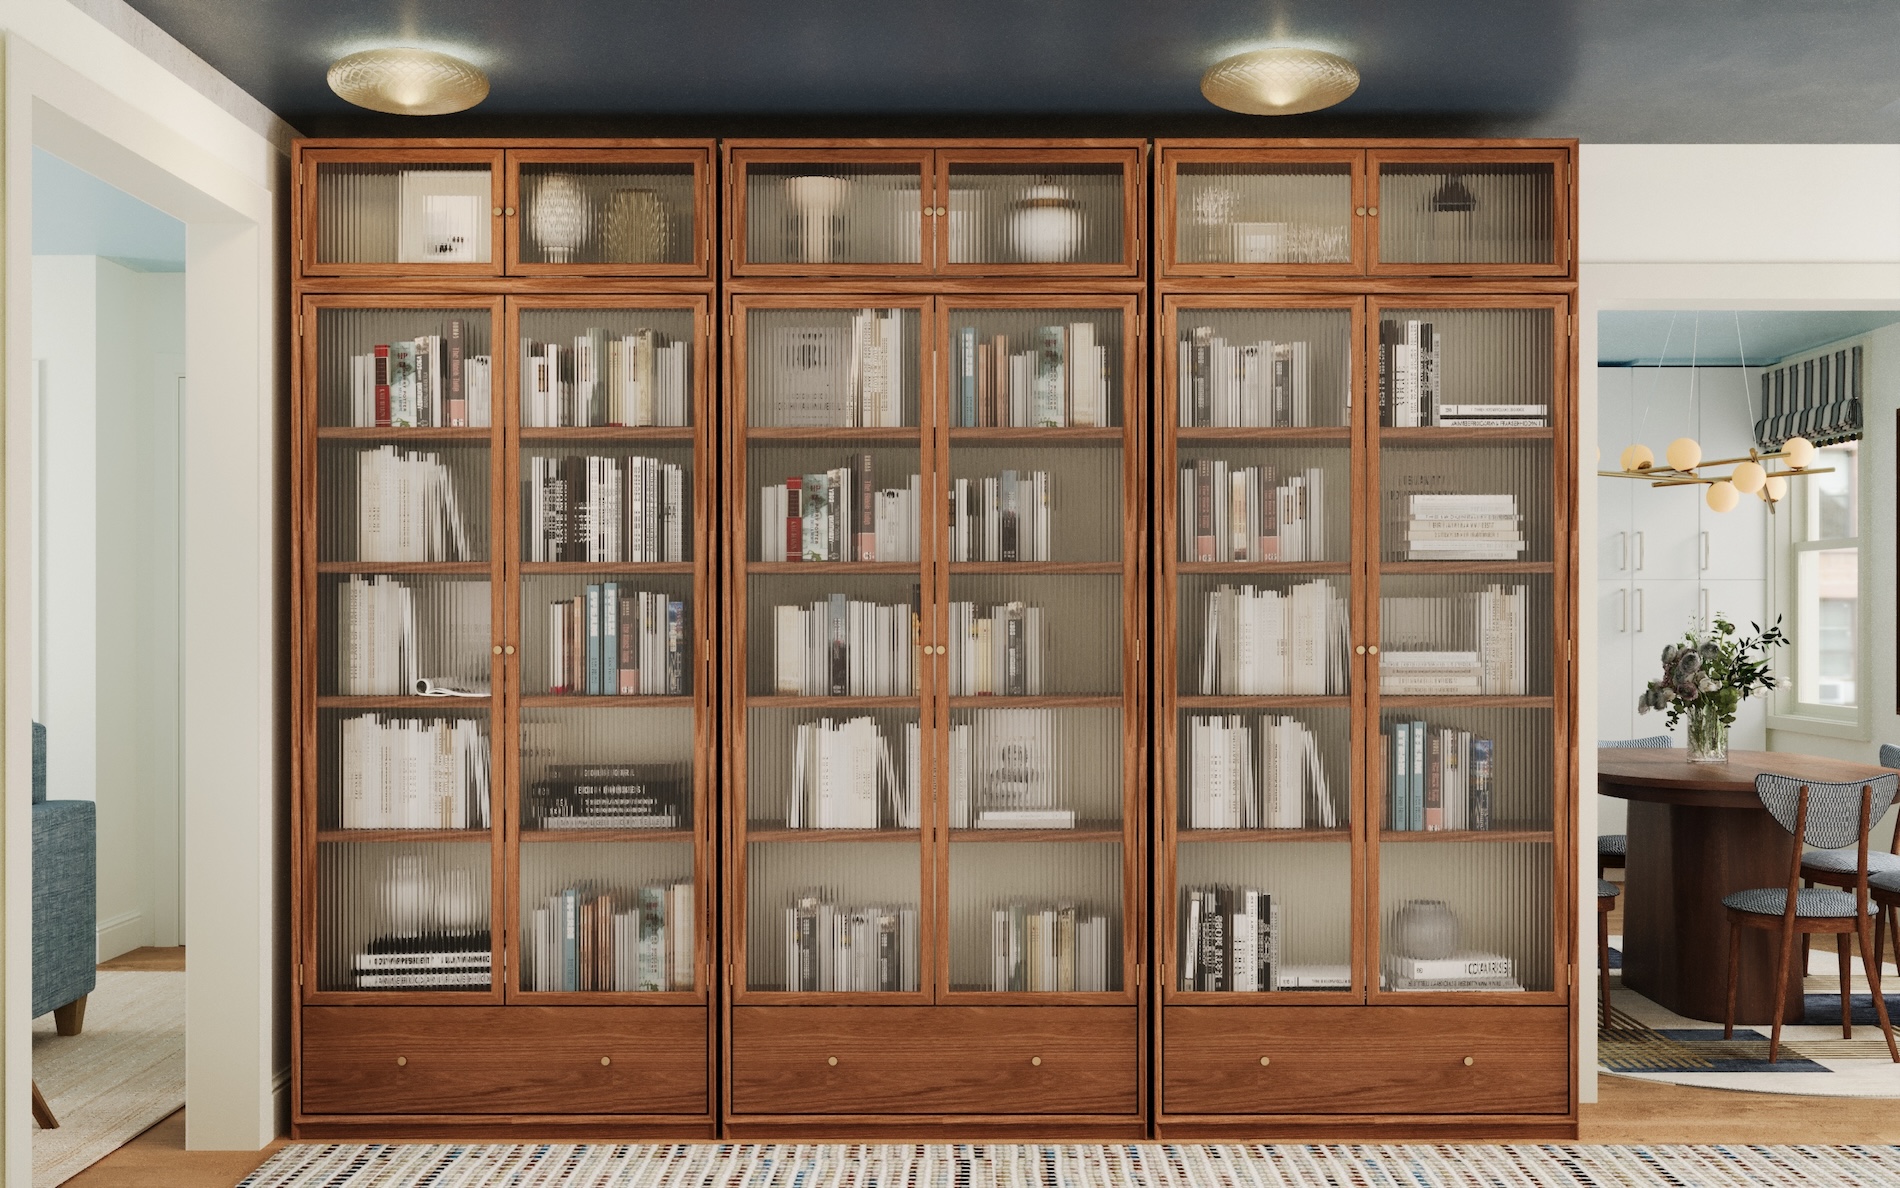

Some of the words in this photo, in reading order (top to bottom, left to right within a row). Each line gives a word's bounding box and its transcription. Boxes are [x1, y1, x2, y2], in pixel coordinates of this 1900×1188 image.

[350, 631, 357, 640] OF
[1215, 915, 1223, 946] MOSS
[1215, 949, 1223, 978] KATE
